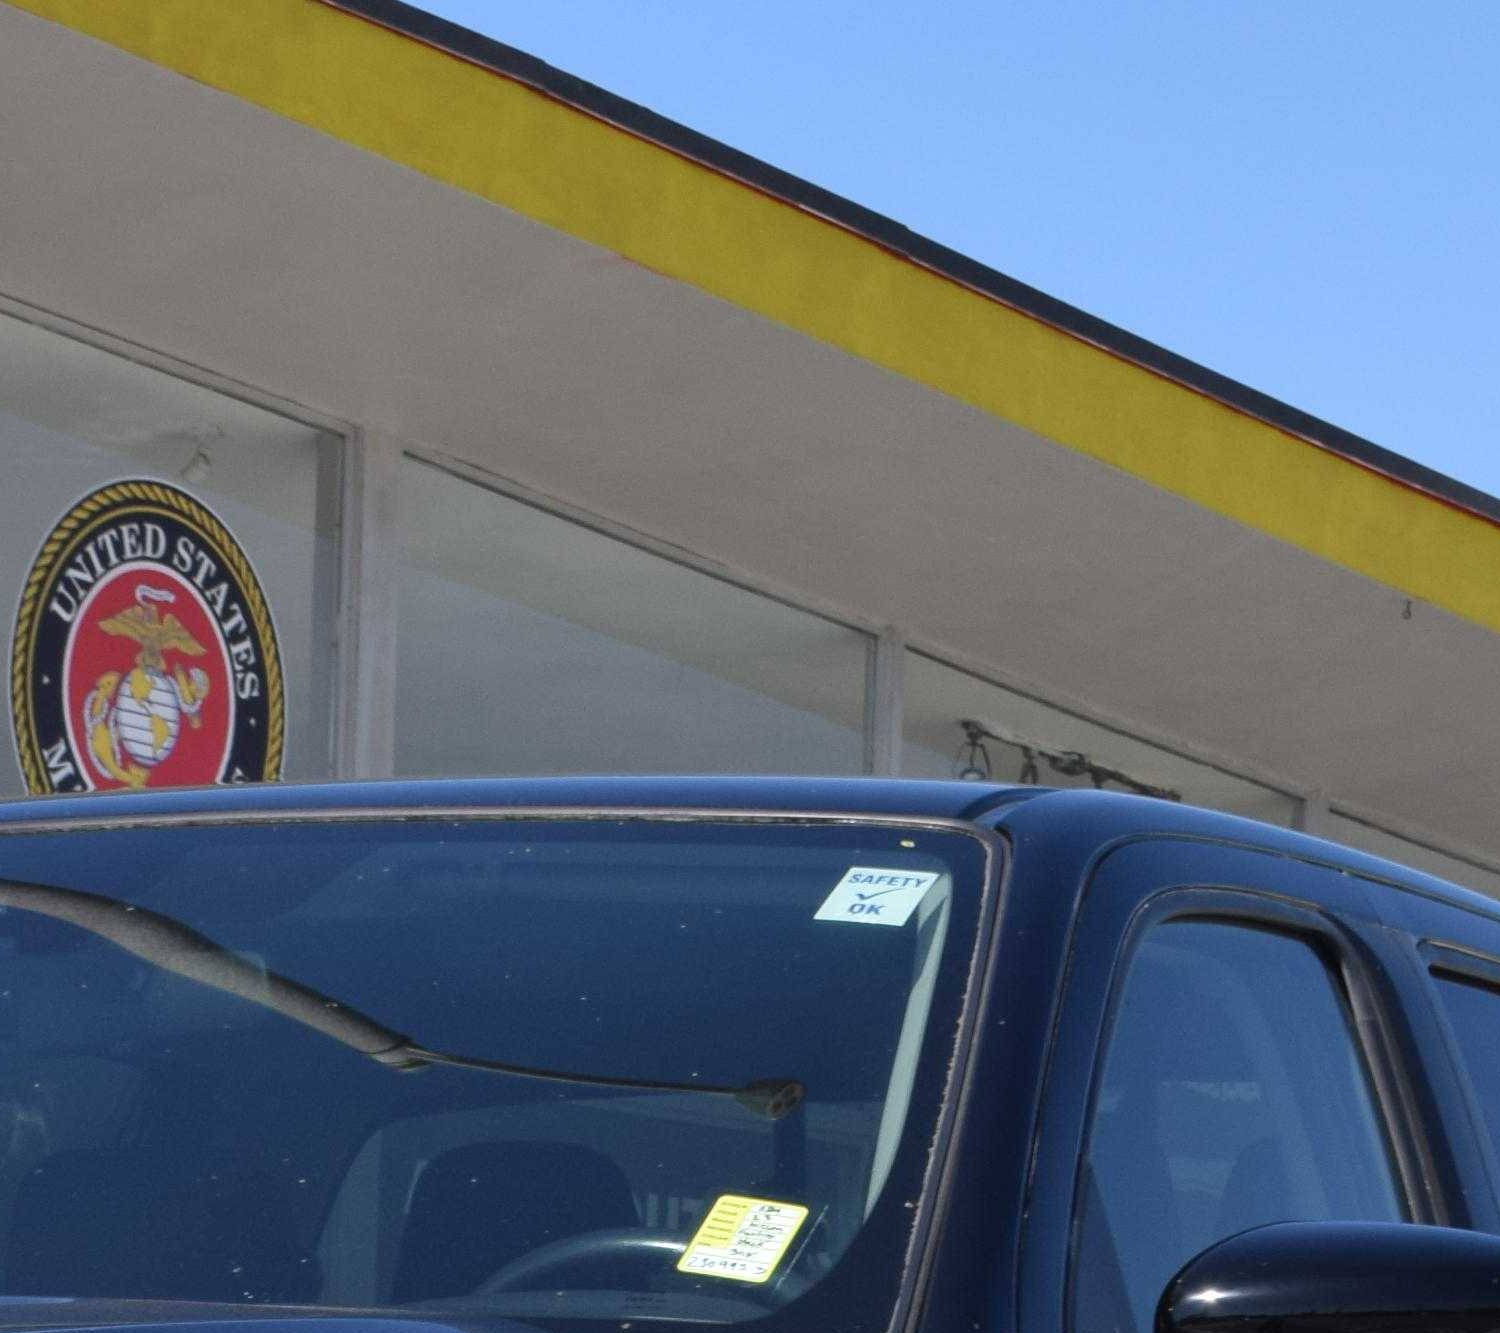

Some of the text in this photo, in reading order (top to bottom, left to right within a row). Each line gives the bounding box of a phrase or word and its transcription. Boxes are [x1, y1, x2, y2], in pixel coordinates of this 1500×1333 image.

[49, 522, 261, 700] UNITED STATES
[847, 872, 928, 889] SAFETY
[847, 903, 886, 916] OK
